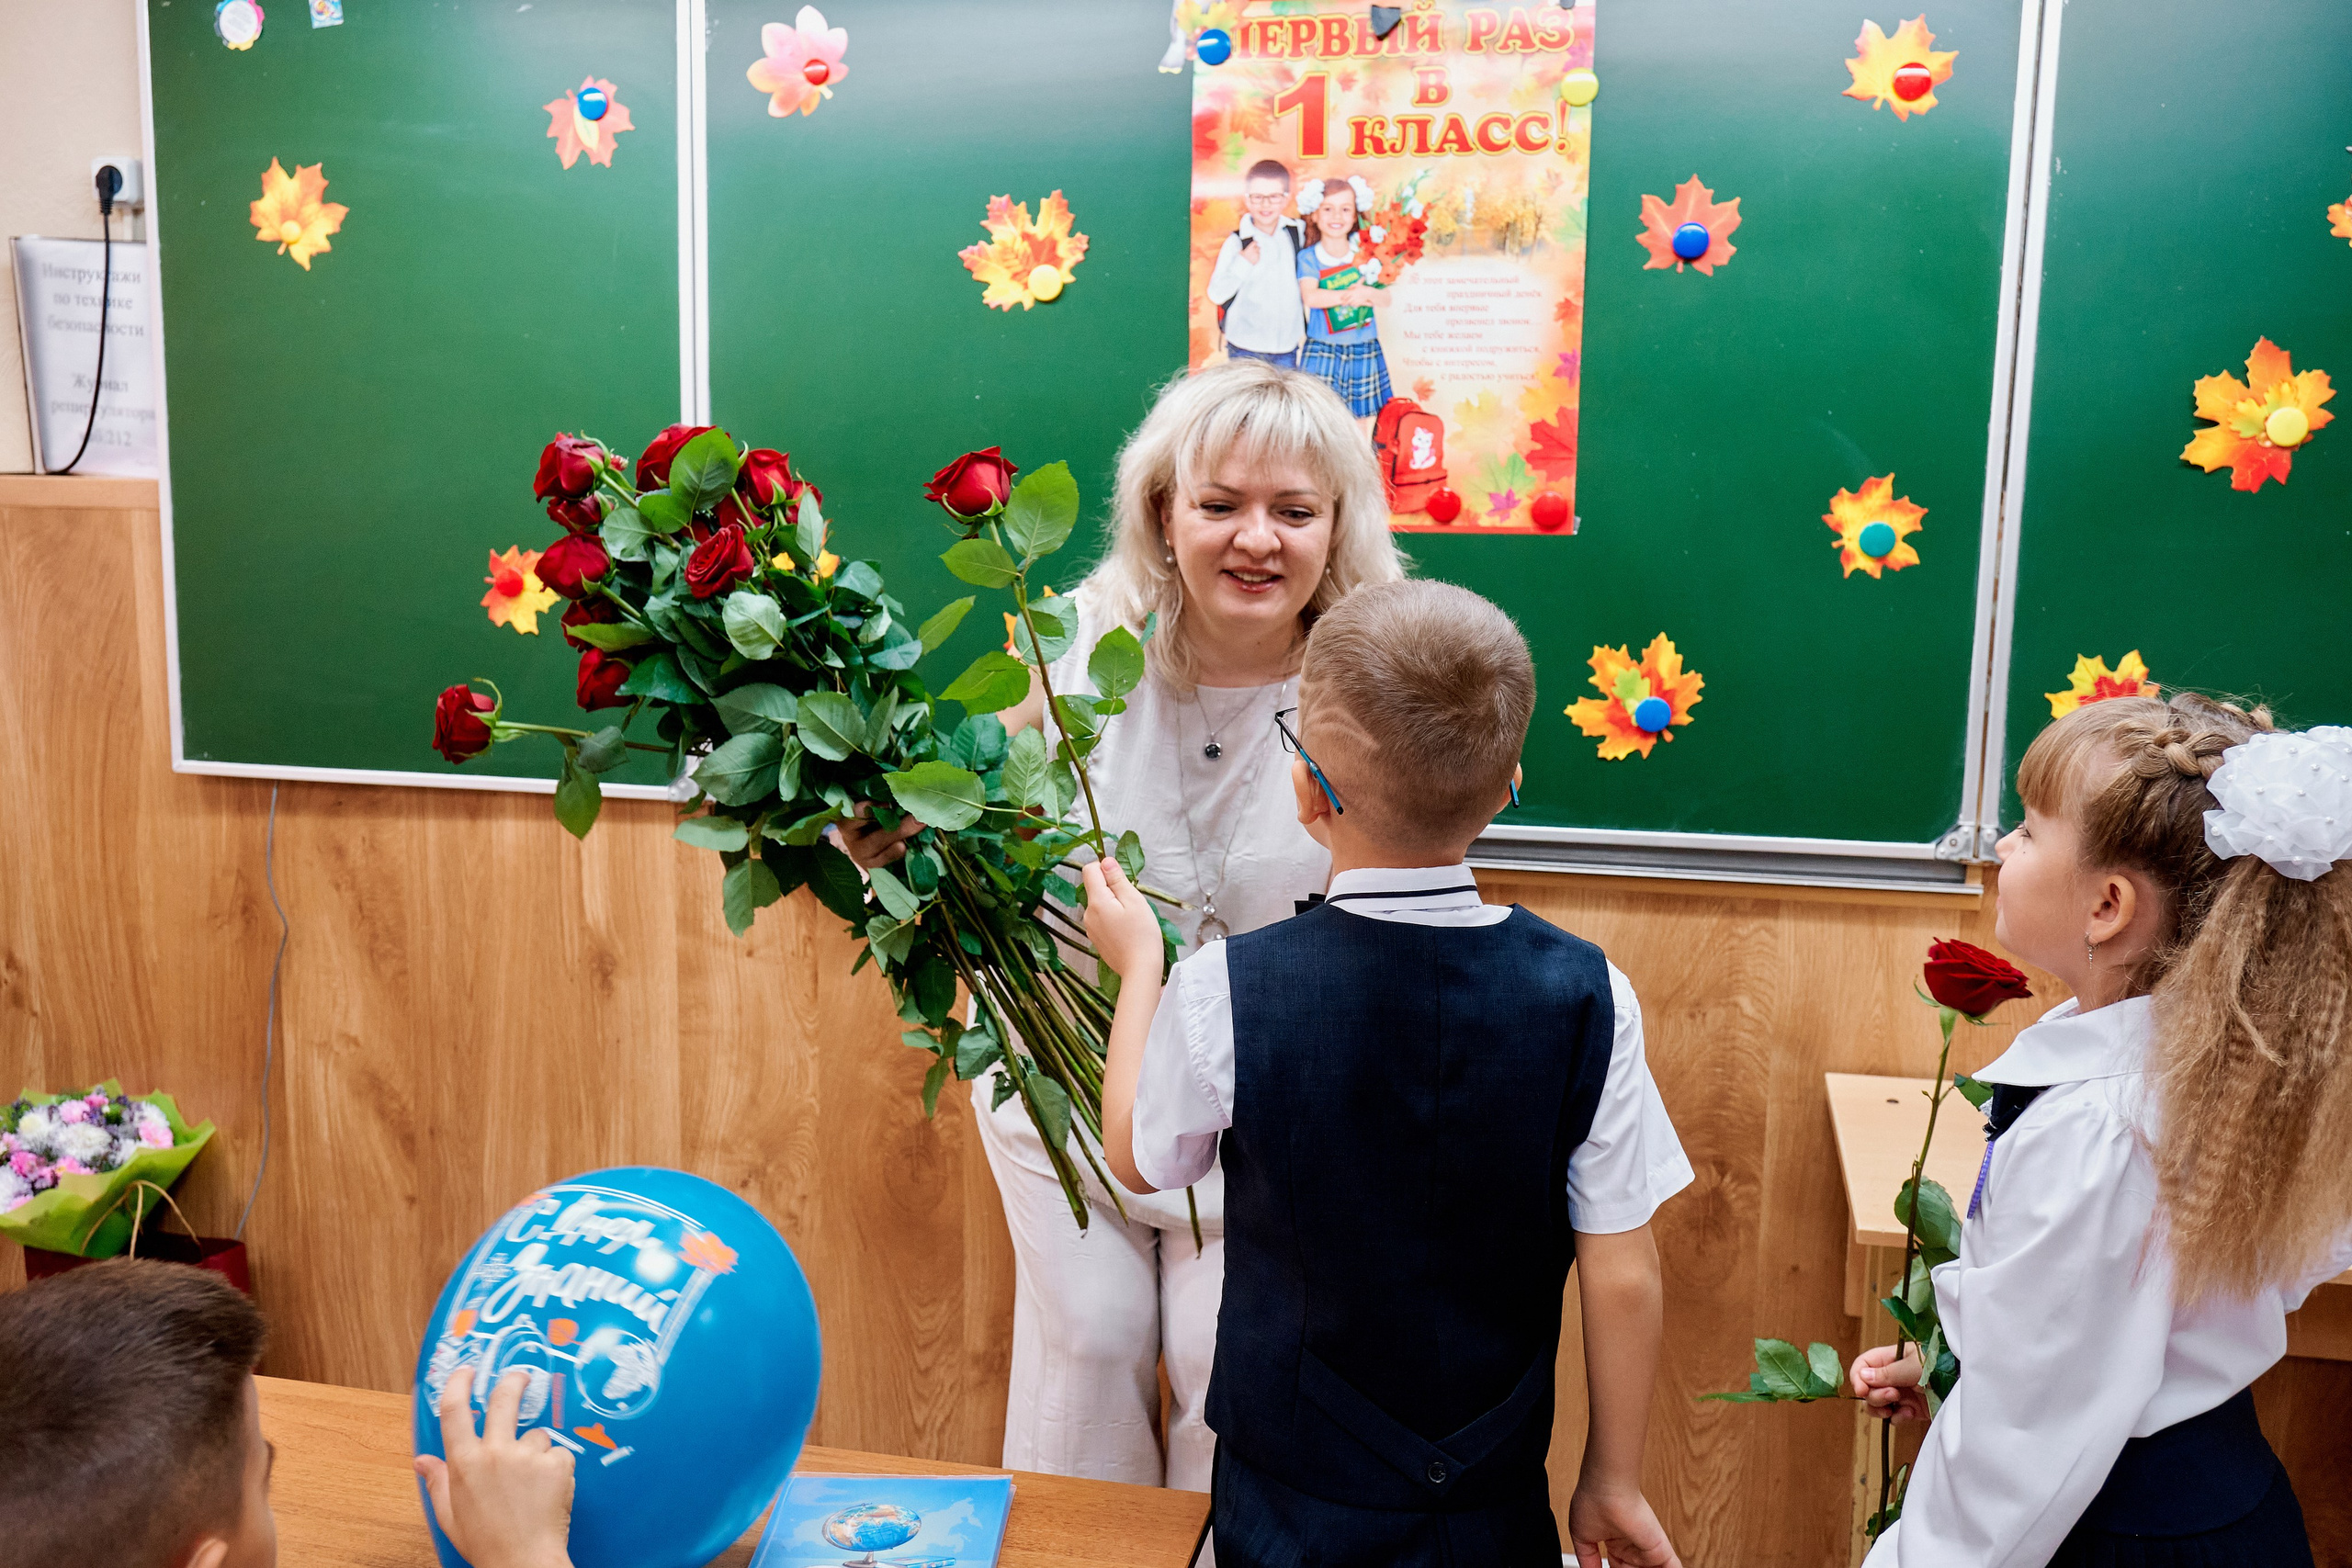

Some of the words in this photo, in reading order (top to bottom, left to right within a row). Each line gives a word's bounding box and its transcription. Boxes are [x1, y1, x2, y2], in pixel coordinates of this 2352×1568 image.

[1464, 6, 1576, 55] РАЗ
[1412, 65, 1451, 107] В
[1274, 71, 1330, 160] 1
[1347, 97, 1571, 159] КЛАСС!
[42, 263, 141, 286] Инструкажи
[53, 291, 72, 307] по
[73, 373, 129, 394] Жунал
